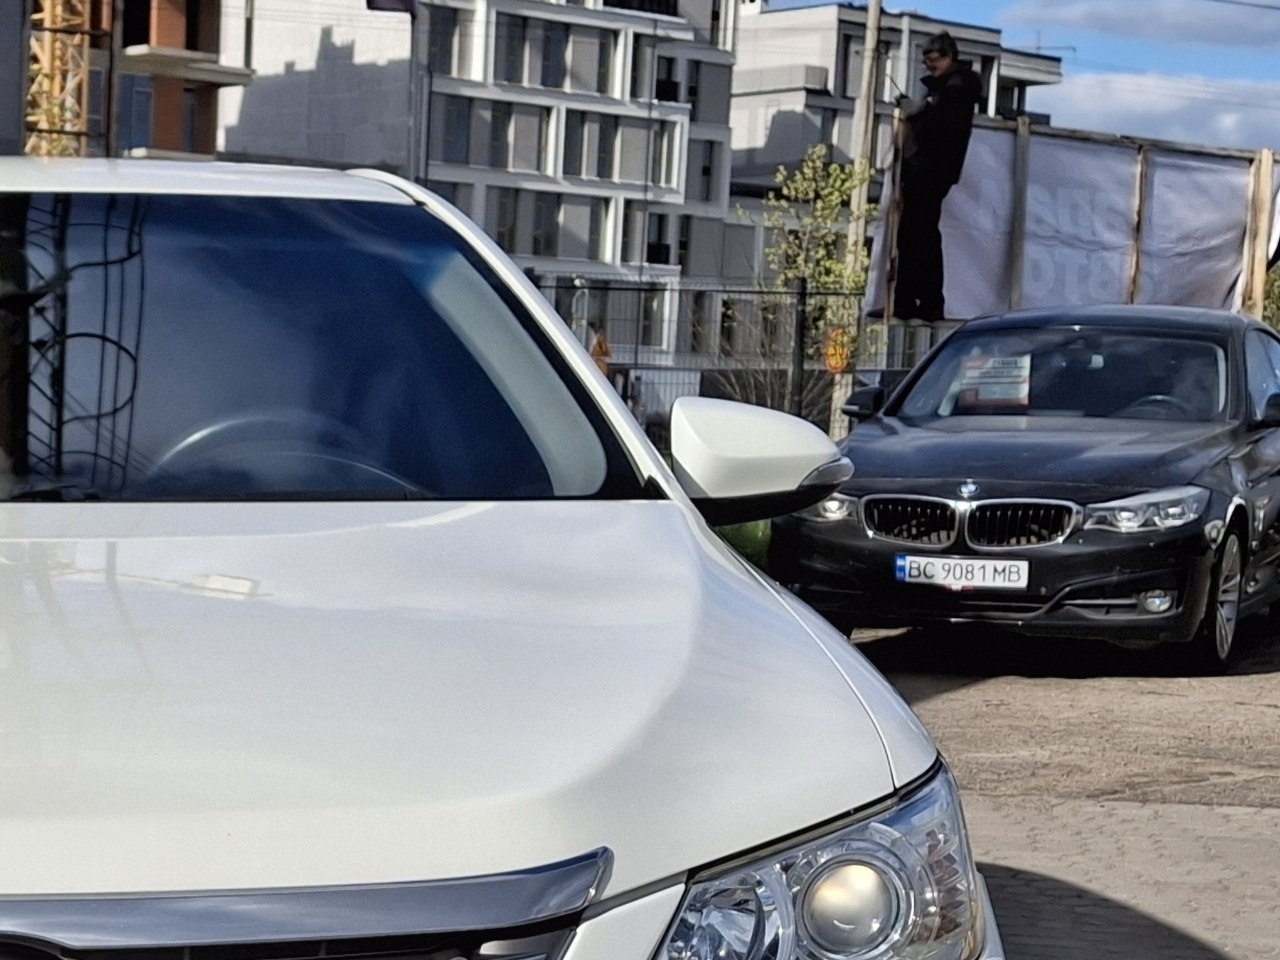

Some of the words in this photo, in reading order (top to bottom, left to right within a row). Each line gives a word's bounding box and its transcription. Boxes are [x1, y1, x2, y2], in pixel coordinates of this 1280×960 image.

[908, 561, 935, 580] BC
[941, 563, 987, 583] 9081
[992, 565, 1022, 584] MB
